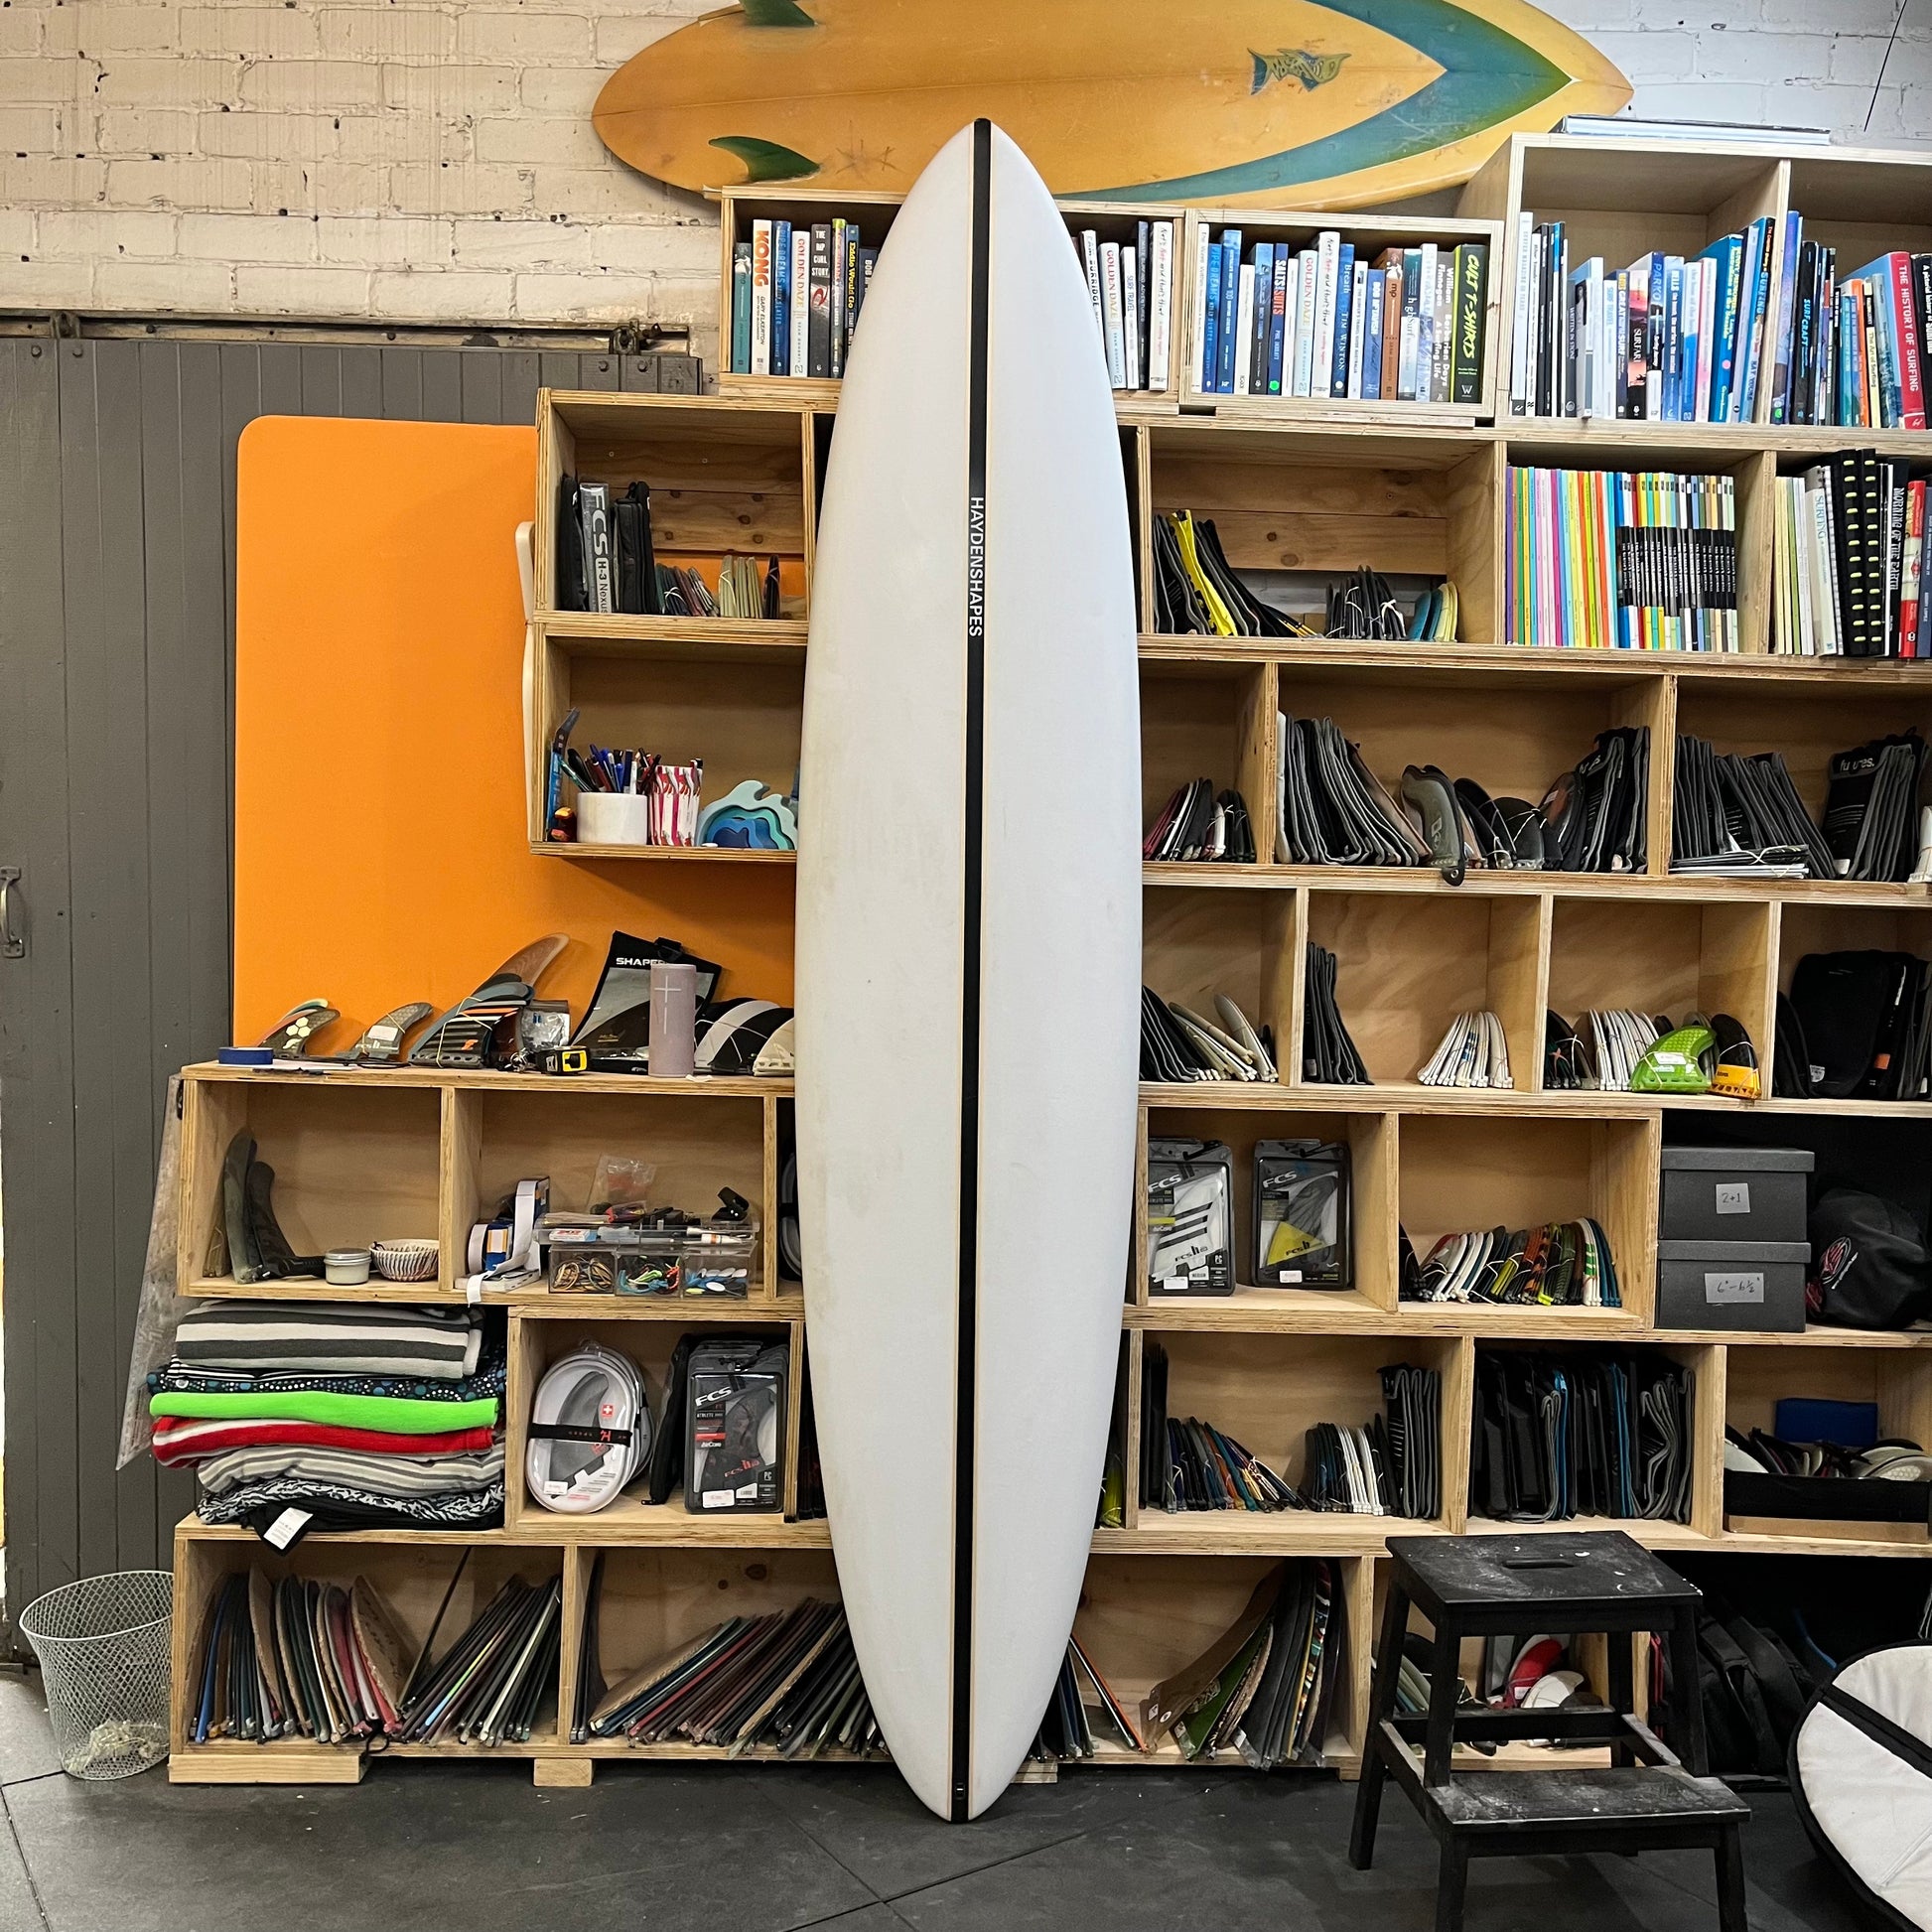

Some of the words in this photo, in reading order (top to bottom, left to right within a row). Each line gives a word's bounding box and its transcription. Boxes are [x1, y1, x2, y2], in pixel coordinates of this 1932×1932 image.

[755, 230, 769, 287] KONG
[1211, 246, 1221, 264] PIPE
[1209, 268, 1220, 300] DREAMS
[1275, 260, 1287, 286] SALTS
[1305, 257, 1313, 297] GOLDEN
[1343, 264, 1352, 293] Breath
[1436, 264, 1446, 307] Finnegan
[1465, 255, 1479, 291] CULT
[1653, 263, 1663, 300] PARKO
[1899, 266, 1908, 284] THE
[1922, 272, 1932, 294] pictorial
[848, 296, 855, 308] Go
[1273, 290, 1285, 315] SUITS
[1389, 284, 1399, 298] mp
[1756, 272, 1769, 315] SURFING
[1901, 289, 1912, 329] HISTORY
[1443, 315, 1451, 360] Barbarian
[1462, 293, 1477, 358] T-SHIRTS
[1905, 334, 1914, 345] OF
[1338, 334, 1347, 370] WINTON
[1433, 331, 1442, 360] Surfing
[1633, 329, 1642, 362] SURFARI
[1907, 349, 1919, 392] SURFING
[592, 487, 609, 555] FCS
[1815, 496, 1827, 539] SURFING
[1892, 487, 1905, 528] MORNING
[1891, 530, 1902, 540] OF
[1890, 542, 1901, 559] THE
[599, 562, 608, 580] H-3
[969, 497, 985, 636] HAYDENSHAPES
[1890, 562, 1900, 590] EARTH
[600, 584, 609, 614] Nexus
[1148, 1174, 1181, 1192] FCS
[1263, 1171, 1298, 1188] FCS
[1722, 1193, 1740, 1203] 2+1
[695, 1387, 732, 1407] FCS
